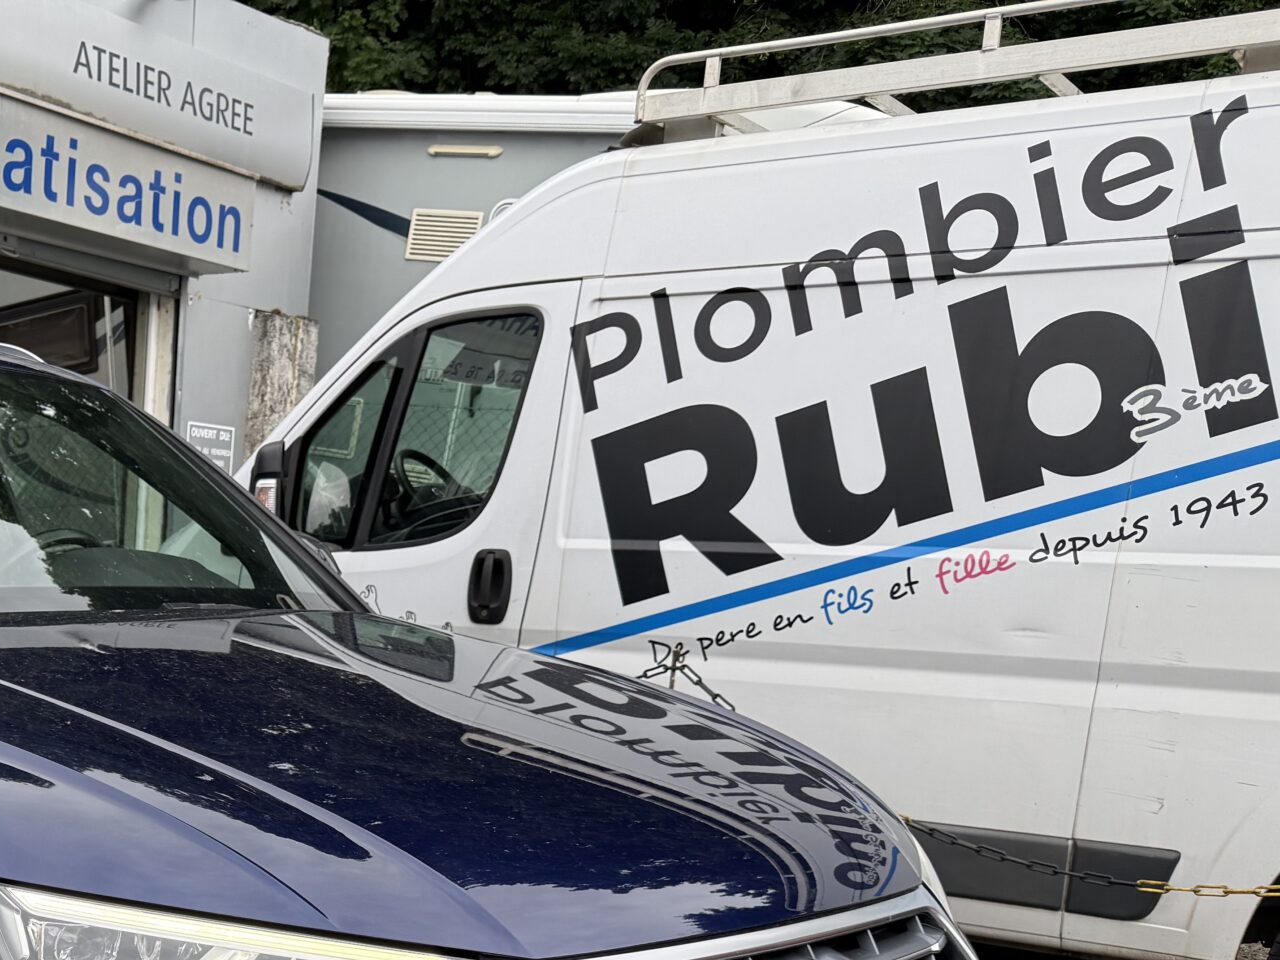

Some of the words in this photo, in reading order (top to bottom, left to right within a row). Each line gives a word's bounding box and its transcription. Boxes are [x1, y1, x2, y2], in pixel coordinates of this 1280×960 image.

[73, 41, 172, 108] ATELIER
[180, 81, 255, 137] AGREE
[571, 95, 1248, 413] Plombier
[191, 427, 217, 439] OUVERT
[591, 205, 1279, 606] Rubi
[1125, 376, 1261, 441] 3ème
[696, 622, 762, 662] pere
[773, 613, 814, 632] en
[820, 585, 874, 626] fils
[890, 566, 919, 601] et
[936, 550, 1016, 594] fille
[1028, 514, 1149, 566] depuis
[1171, 481, 1270, 529] 1943
